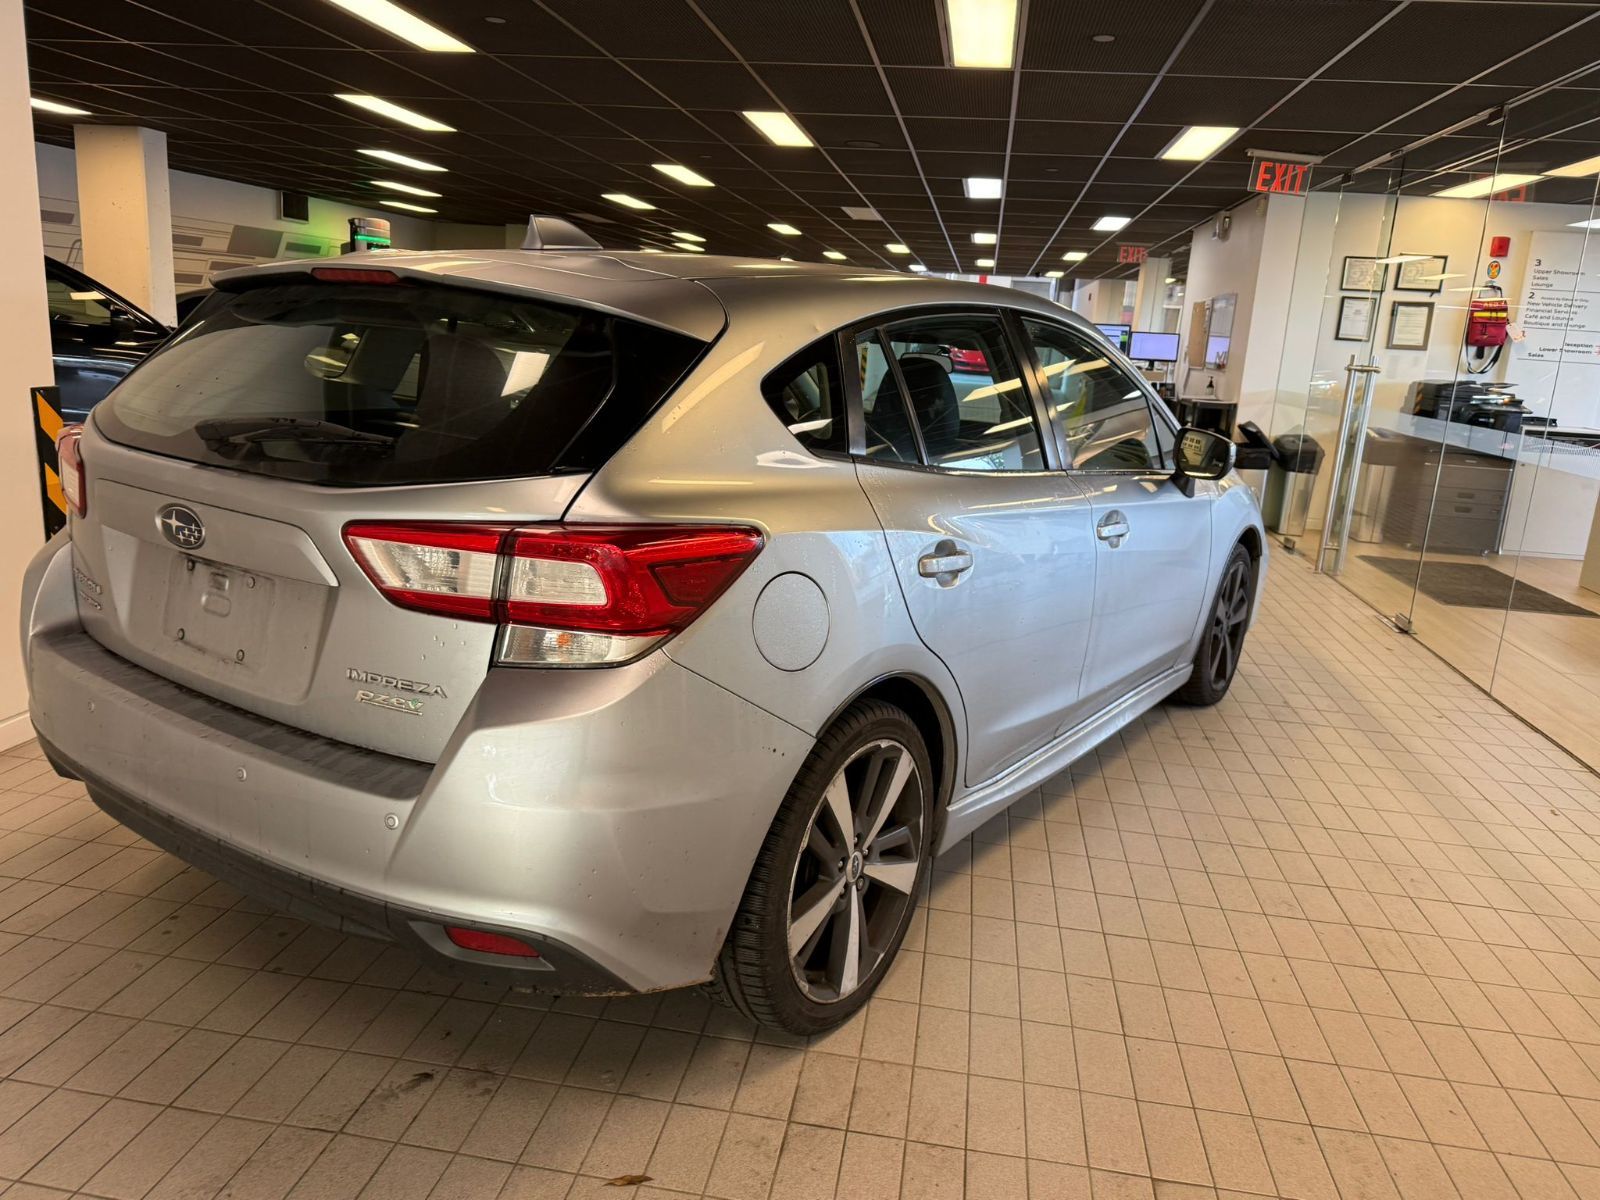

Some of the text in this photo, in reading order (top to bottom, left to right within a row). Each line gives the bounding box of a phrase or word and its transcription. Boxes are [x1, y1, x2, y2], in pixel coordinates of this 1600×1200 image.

[1256, 162, 1308, 194] EXIT
[1535, 259, 1542, 267] 3
[1528, 291, 1536, 299] 2
[346, 668, 448, 699] IMPREZA
